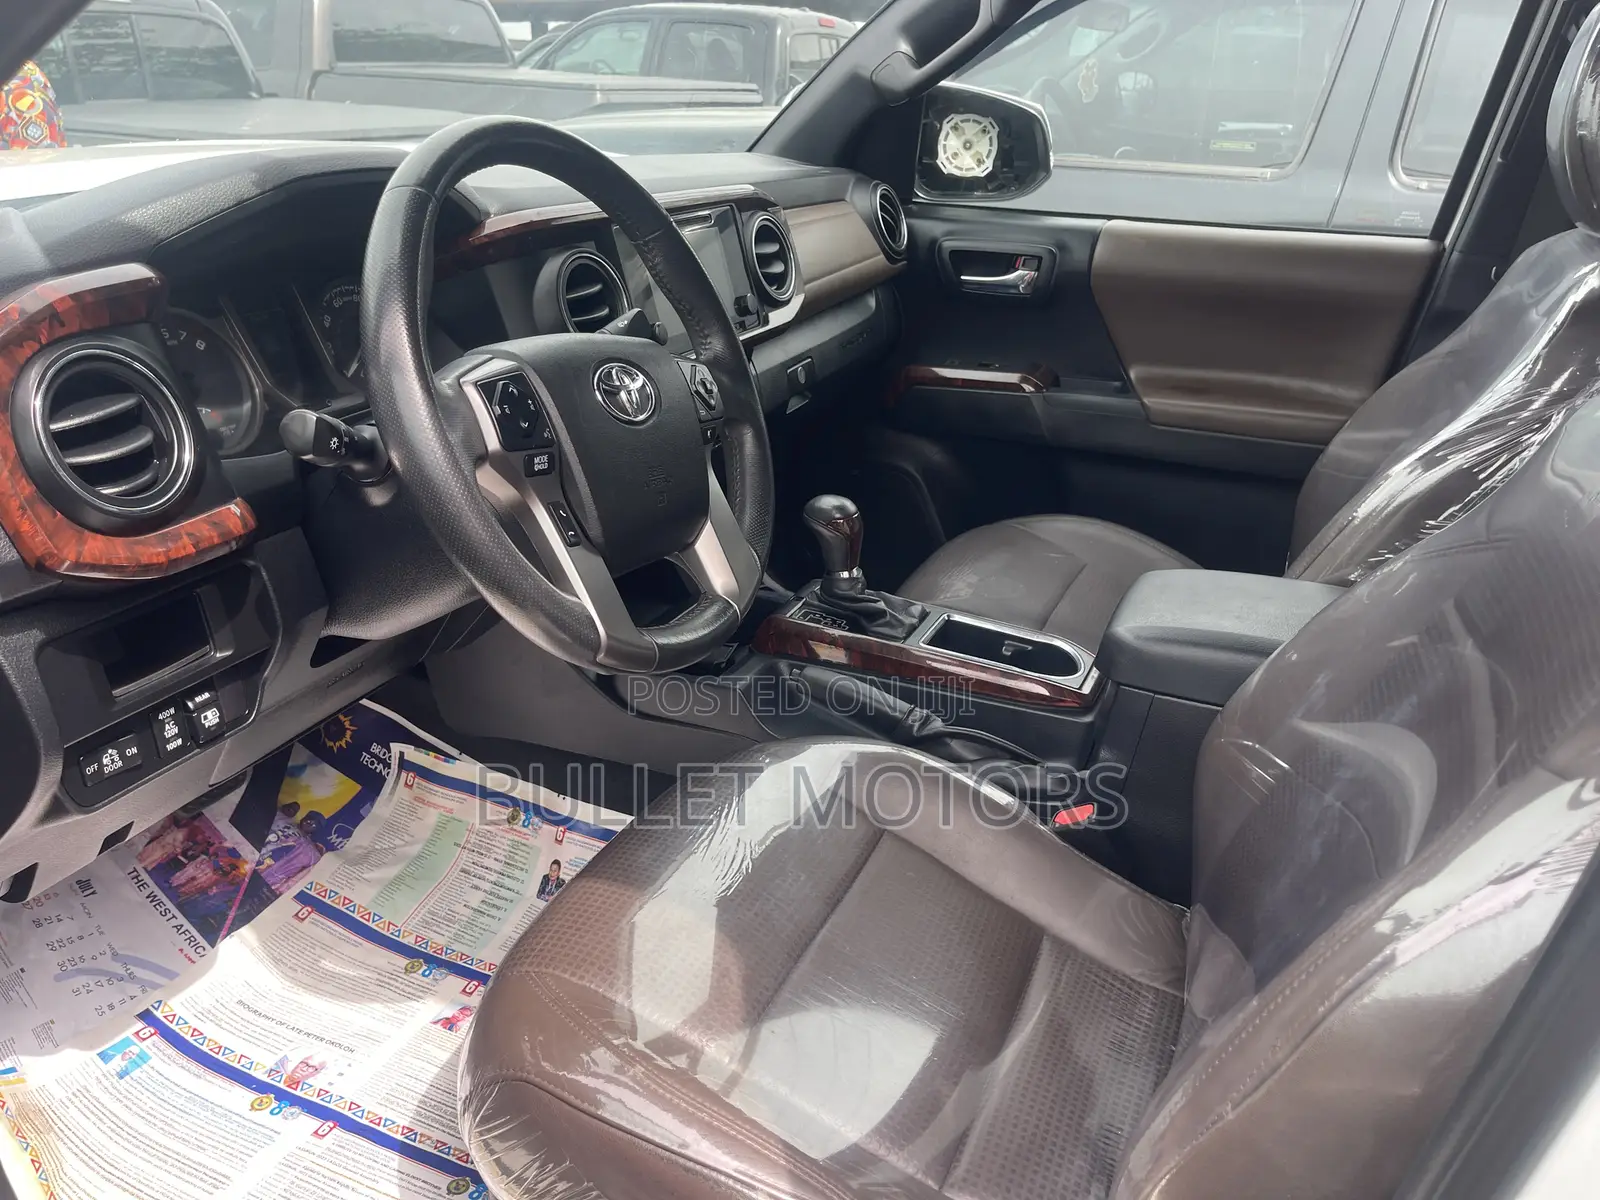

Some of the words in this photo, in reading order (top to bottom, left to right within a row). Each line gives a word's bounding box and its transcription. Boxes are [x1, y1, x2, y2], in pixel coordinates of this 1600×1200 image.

[179, 330, 187, 340] 7
[196, 340, 206, 350] 8
[534, 455, 548, 464] MODE
[194, 692, 210, 703] REAR
[158, 707, 175, 720] 400W
[165, 721, 176, 731] AC
[205, 717, 220, 728] PUSH
[164, 726, 179, 738] 120V
[126, 746, 138, 757] ON
[166, 738, 182, 752] 100W
[86, 763, 99, 775] OFF
[104, 760, 123, 774] DOOR
[76, 878, 98, 898] JULY
[127, 867, 150, 892] THE
[145, 891, 178, 922] WEST
[80, 902, 93, 919] MON
[95, 924, 106, 936] TUE
[107, 942, 119, 957] WED
[120, 962, 137, 981] THURS
[138, 985, 148, 995] FRI
[32, 918, 43, 928] 28
[46, 941, 57, 952] 29
[57, 961, 68, 972] 30
[71, 987, 82, 997] 31
[55, 914, 63, 922] 14
[66, 936, 75, 945] 15
[78, 955, 86, 964] 16
[95, 980, 104, 988] 17
[106, 1003, 116, 1012] 18
[44, 916, 53, 924] 21
[56, 938, 67, 950] 22
[67, 957, 78, 967] 23
[82, 982, 94, 995] 24
[94, 1005, 107, 1017] 25
[106, 978, 115, 986] 10
[118, 997, 127, 1006] 11
[236, 999, 277, 1023] BIOGRAPHY
[285, 1024, 304, 1036] LATE
[303, 1031, 326, 1043] PETER
